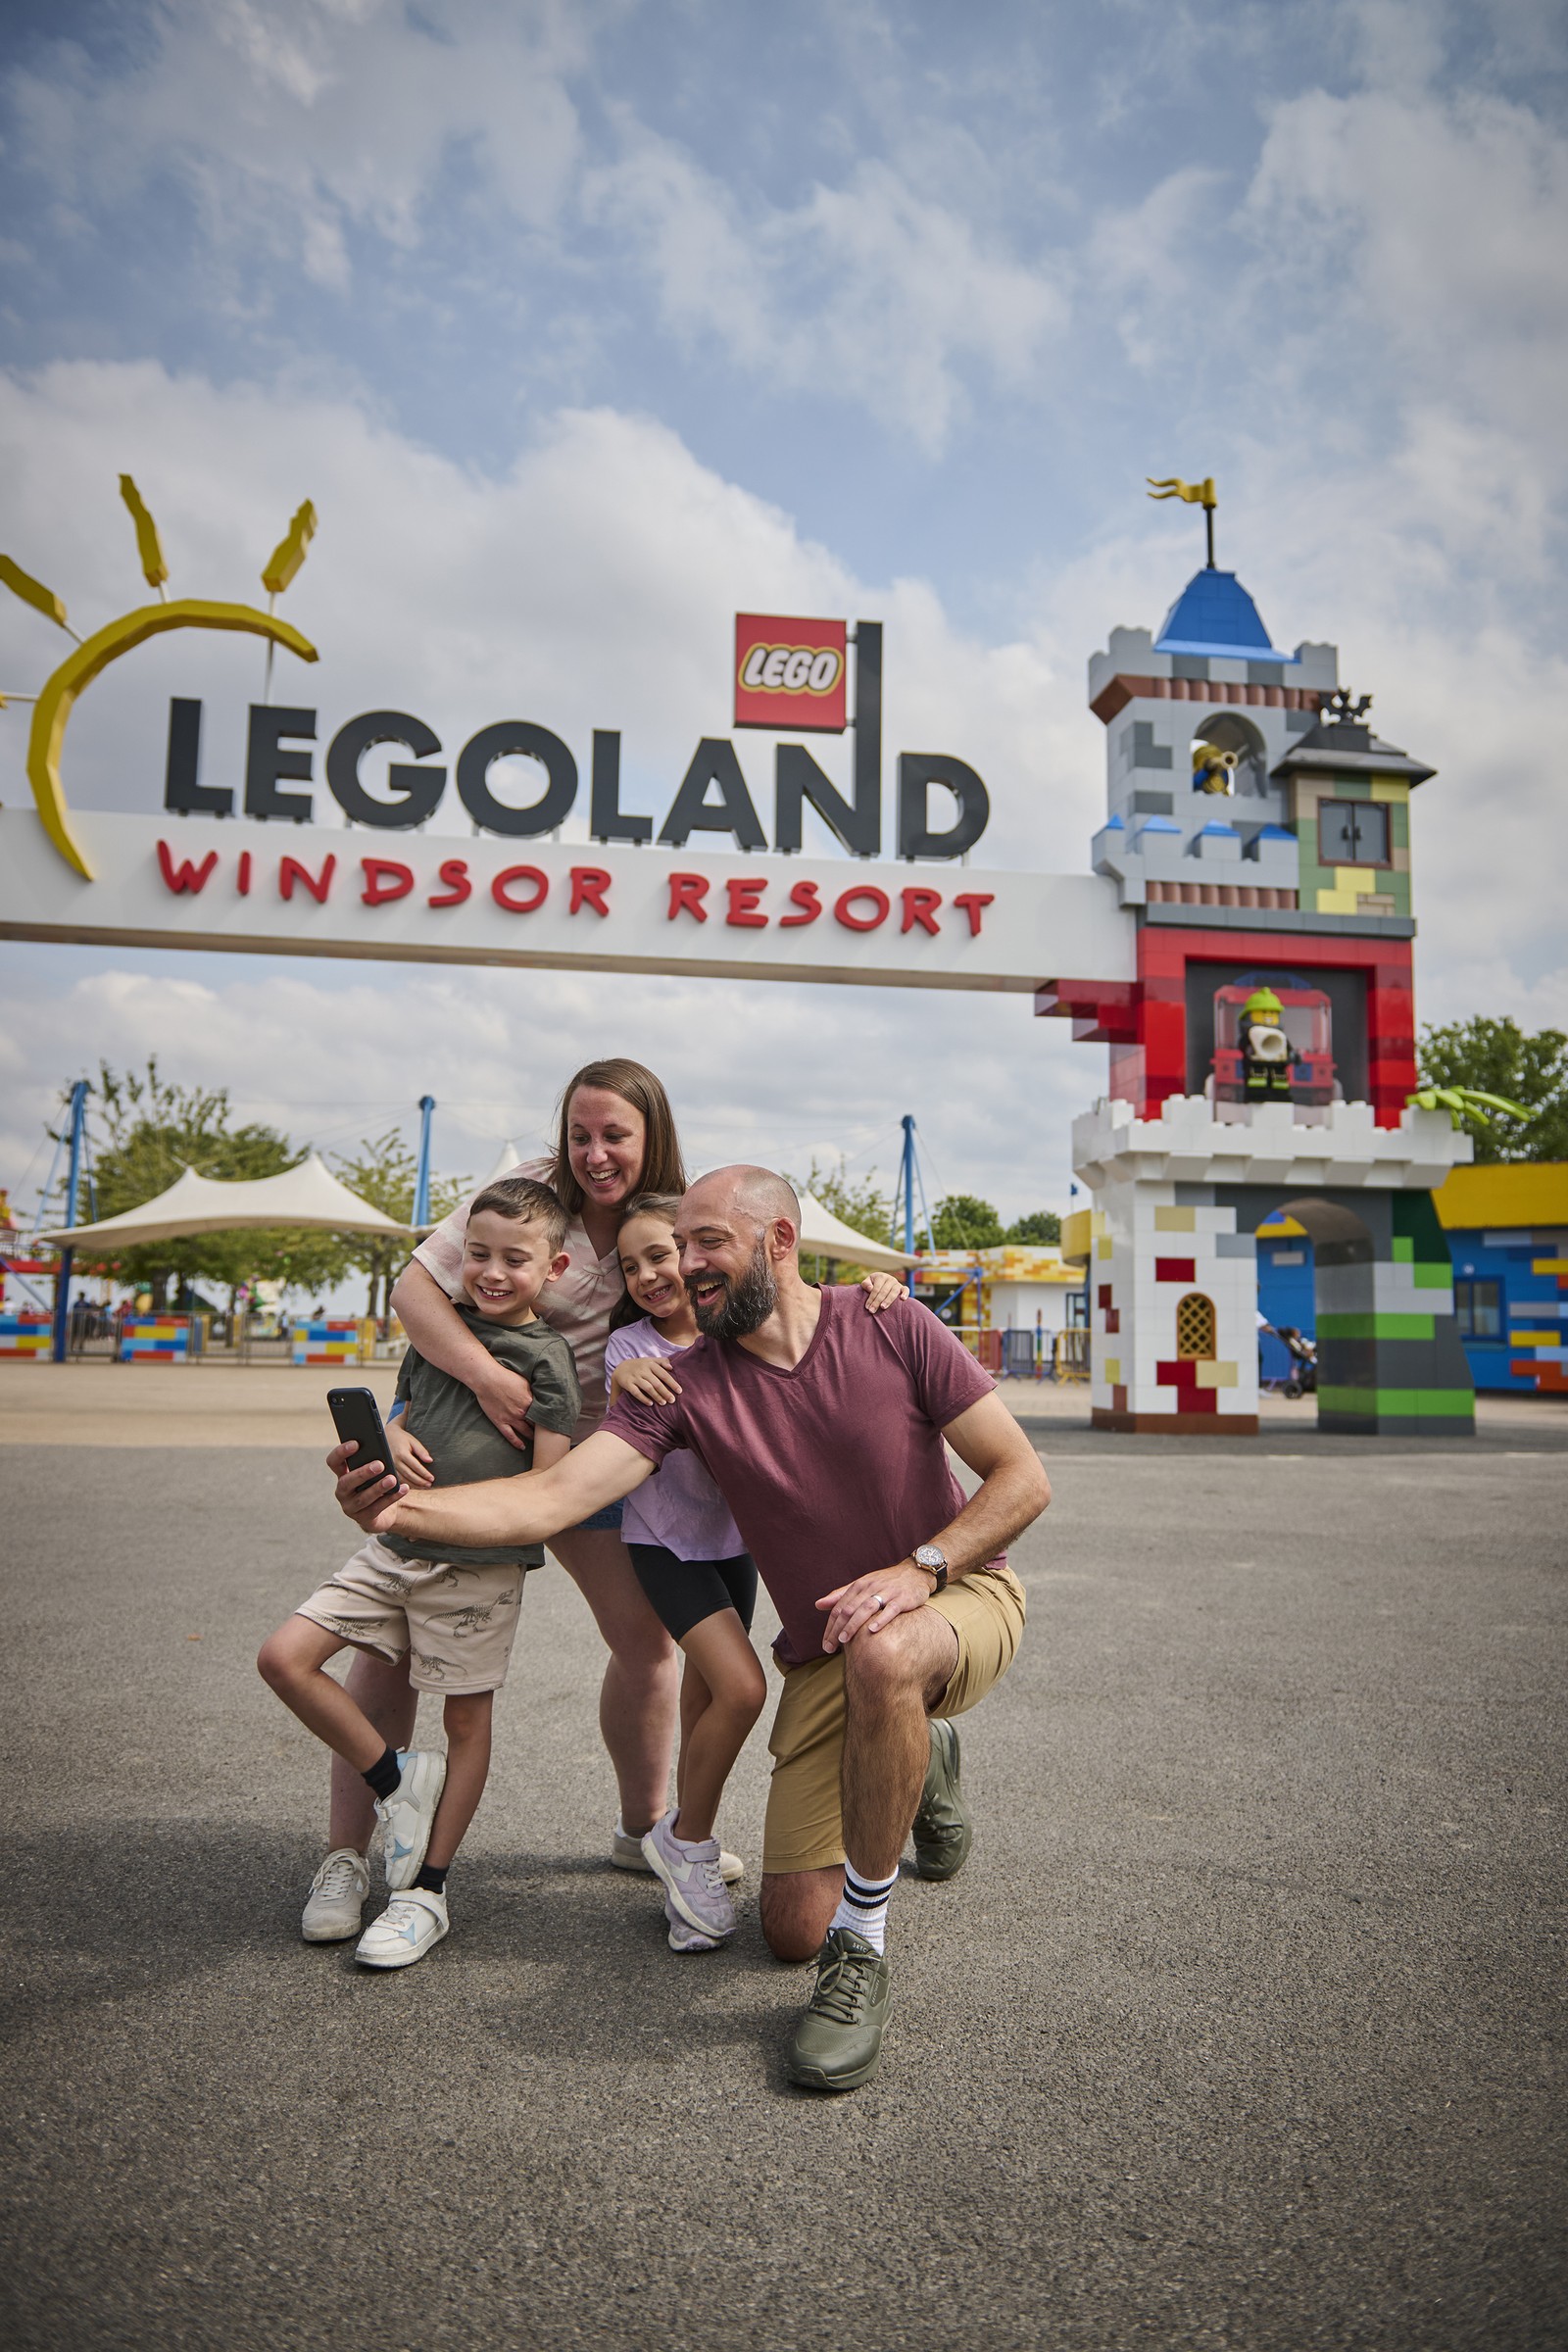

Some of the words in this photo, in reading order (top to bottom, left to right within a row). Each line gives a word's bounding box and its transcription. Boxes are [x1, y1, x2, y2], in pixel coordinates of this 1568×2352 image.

[743, 648, 839, 690] LEGO
[165, 620, 991, 861] LEGOLAND
[157, 840, 612, 917] WINDSOR
[668, 872, 995, 937] RESORT
